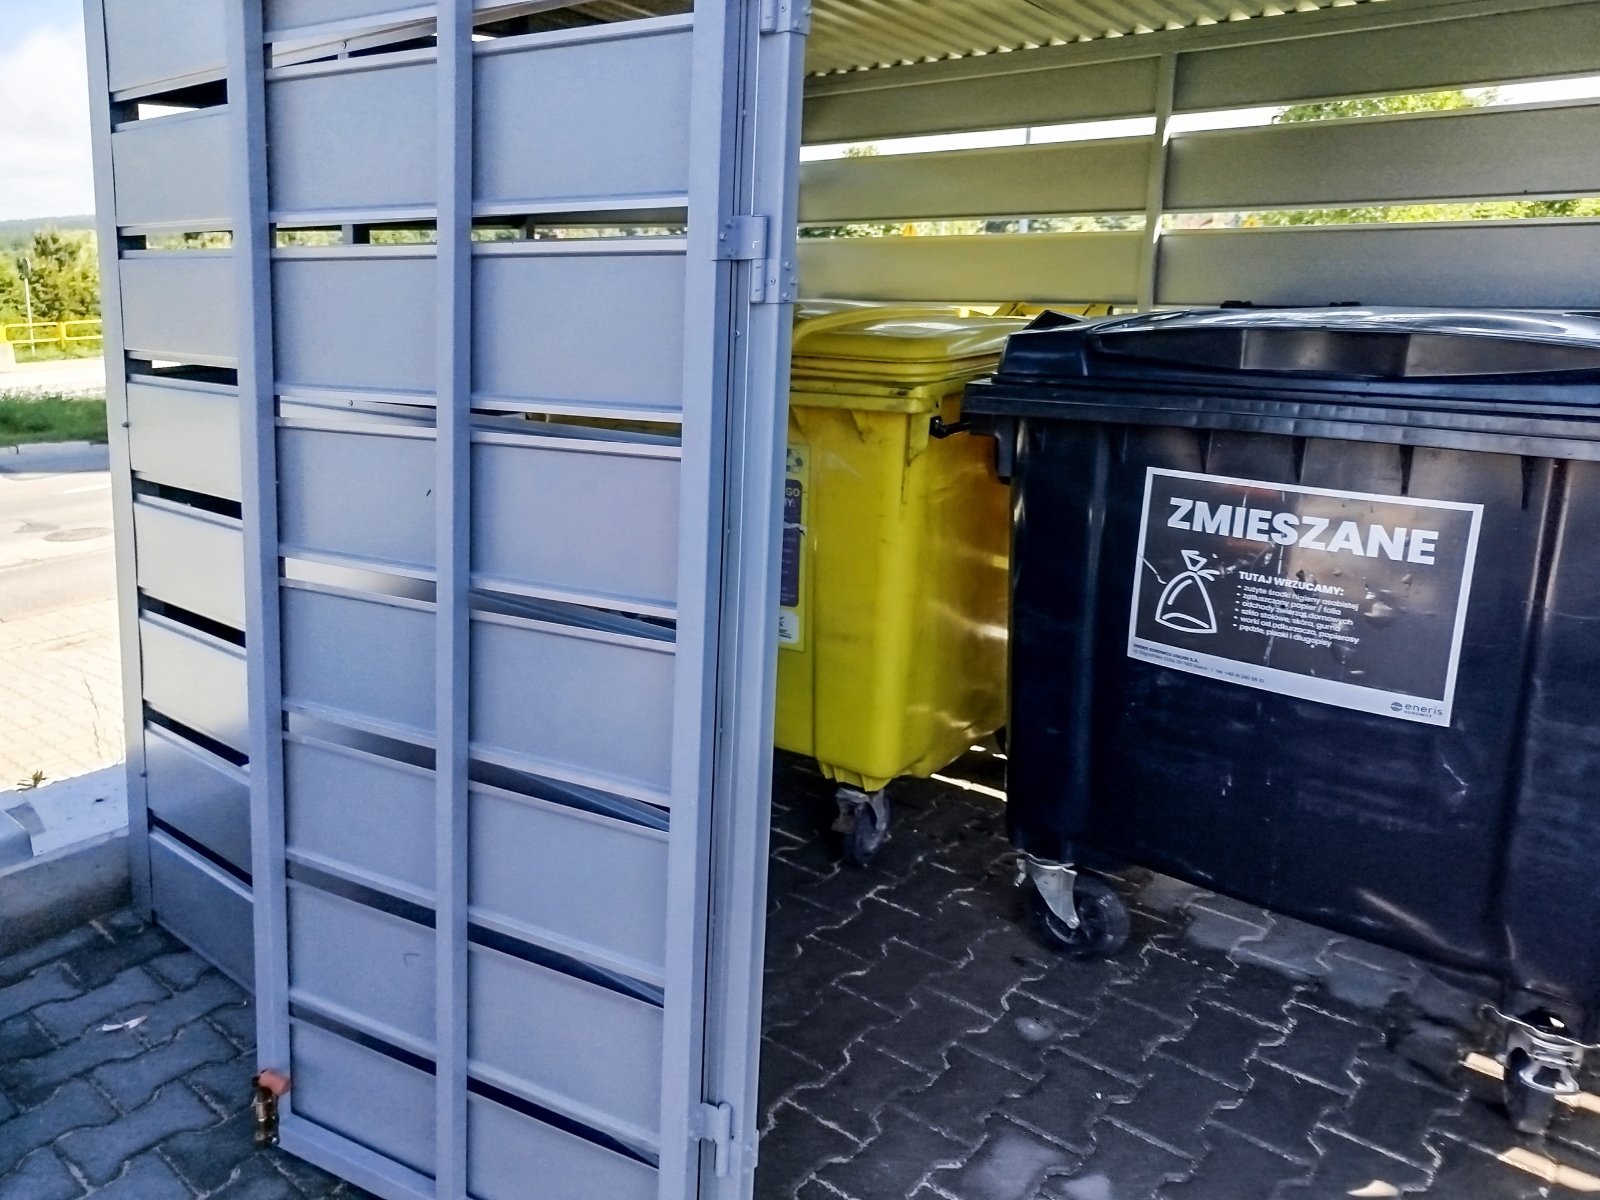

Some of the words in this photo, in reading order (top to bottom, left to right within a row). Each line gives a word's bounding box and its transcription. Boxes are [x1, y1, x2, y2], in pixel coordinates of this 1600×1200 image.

[1167, 496, 1439, 565] ZMIESZANE
[1238, 571, 1272, 584] TUTAJ
[1274, 576, 1345, 596] WRZUCAMY:
[1404, 704, 1443, 716] eneris
